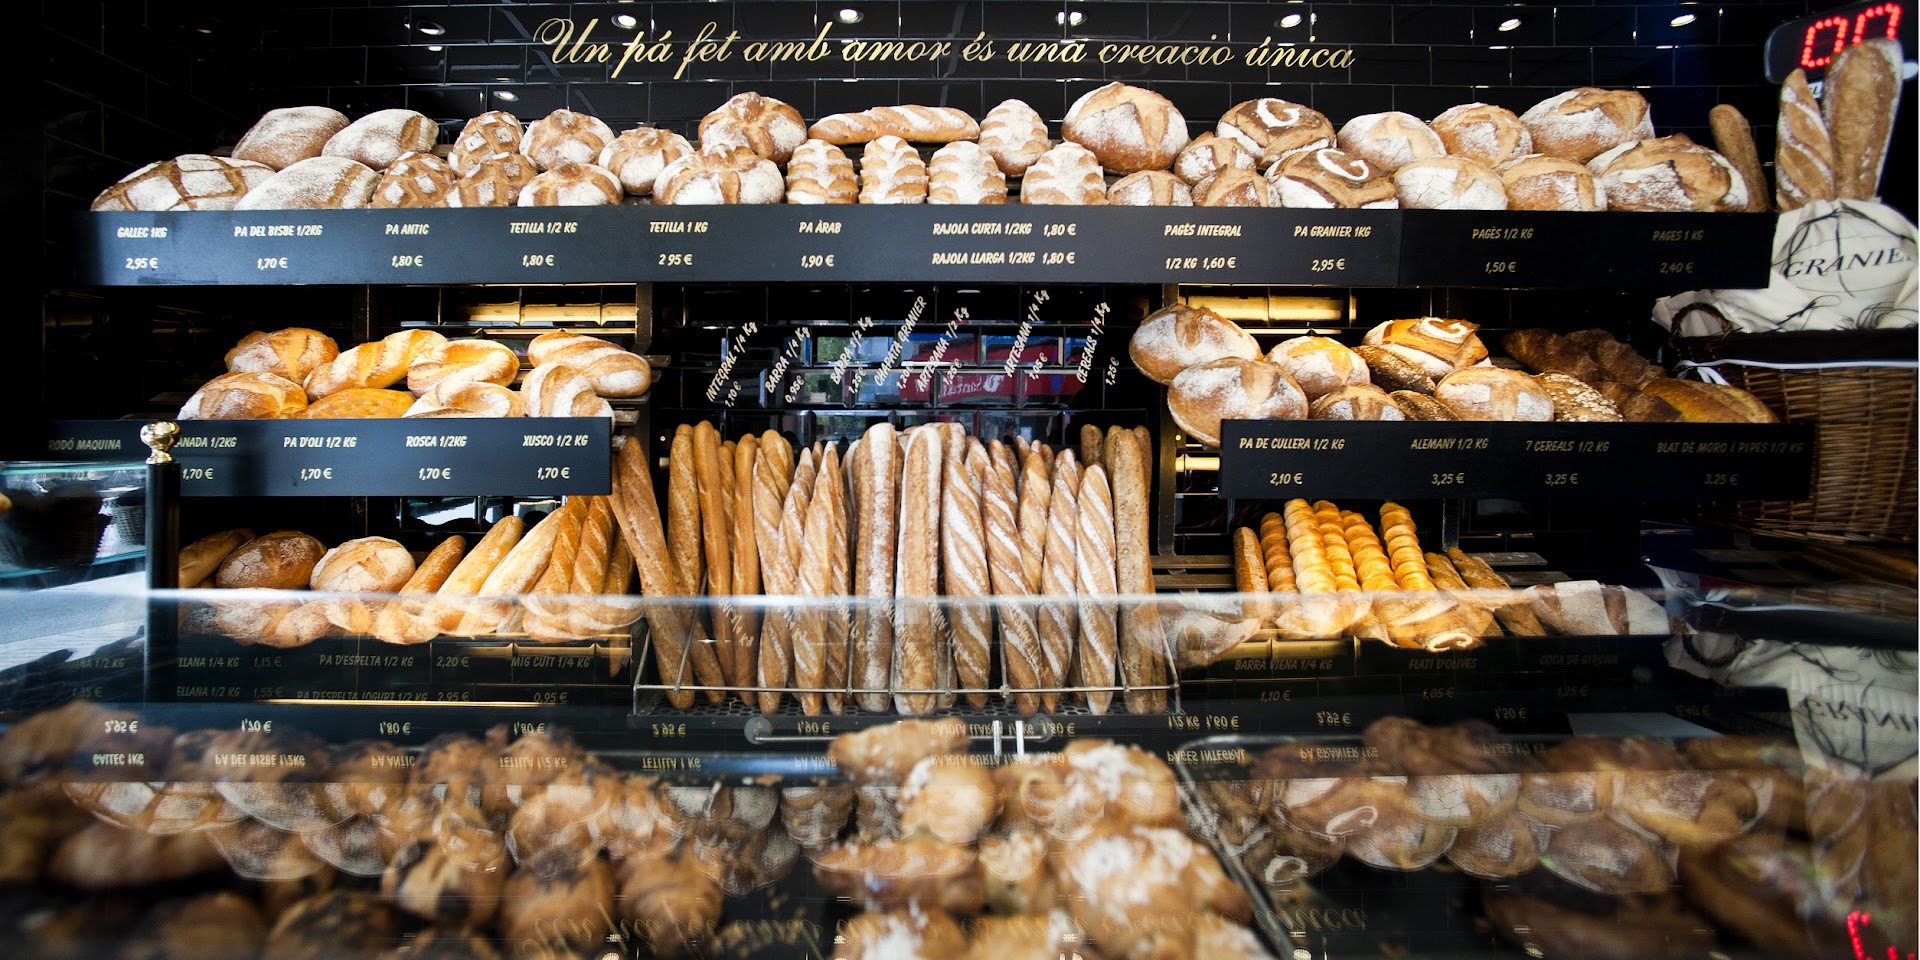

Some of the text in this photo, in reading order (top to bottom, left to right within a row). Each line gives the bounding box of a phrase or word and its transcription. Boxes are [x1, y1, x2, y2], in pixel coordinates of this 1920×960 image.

[532, 18, 612, 64] Un
[611, 30, 673, 79] pá
[673, 21, 740, 80] fet
[743, 21, 833, 63] amb
[842, 40, 951, 63] amor
[962, 31, 996, 62] és
[1007, 41, 1088, 64] una
[1245, 35, 1355, 70] única
[116, 226, 168, 239] GALLEC 1KG
[233, 224, 324, 237] PA DEL BISBE 1/2KG
[385, 223, 430, 235] PA ANTIC
[510, 221, 578, 234] TETILLA 1/2 KG
[649, 221, 709, 233] TETILLA 1 KG
[798, 219, 842, 234] PA ÀRAB
[932, 222, 1077, 238] RAJOLA CURTA 1/2KG 1,80 €
[1164, 223, 1242, 237] PAGÈS INTEGRAL
[1293, 225, 1372, 238] PA GRANIER 1KG
[1503, 228, 1519, 240] 1/2
[1520, 228, 1534, 239] KG
[125, 257, 159, 271] 2,95 €
[257, 256, 288, 271] 1,70 €
[391, 254, 424, 268] 1,80 €
[522, 254, 555, 268] 1,80 €
[683, 253, 693, 266] €
[801, 254, 835, 269] 1,90 €
[931, 251, 1076, 265] RAJOLA LLARGA 1/2KG 1,80 €
[1165, 256, 1237, 271] 1/2 KG 1,60 €
[1311, 258, 1346, 272] 2,95 €
[1785, 247, 1911, 278] GRANIE
[1485, 261, 1517, 274] 1,50 €
[1003, 289, 1050, 377] ARTESANA 1/4 Kg
[873, 340, 902, 387] CHAPATA
[897, 295, 927, 343] GRANIER
[1076, 301, 1111, 384] CEREALS 1/4 Kg
[830, 316, 874, 385] BARRA 1/2 Kg
[915, 337, 950, 392] ARTESANA
[945, 320, 960, 339] 1/2
[953, 306, 970, 321] Kg
[706, 321, 758, 402] INTEGRAL 1/4 Kg
[765, 326, 811, 393] BARRA 1/4 Kg
[173, 436, 237, 449] ANADA 1/2KG
[283, 436, 357, 449] PA D'OLI 1/2 KG
[405, 435, 468, 448] ROSCA 1/2KG
[522, 434, 589, 447] XUSCO 1/2 KG
[1239, 437, 1345, 451] PA DE CULLERA 1/2 KG
[1410, 437, 1489, 450] ALEMANY 1/2 KG
[1525, 440, 1610, 452] 7 CEREALS 1/2 KG
[182, 467, 214, 480] 1,70 €
[300, 467, 333, 482] 1,70 €
[418, 467, 451, 481] 1,70 €
[537, 466, 570, 481] 1,70 €
[1269, 472, 1303, 486] 2,10 €
[1431, 472, 1465, 486] 3,25 €
[1544, 472, 1579, 487] 3,25 €
